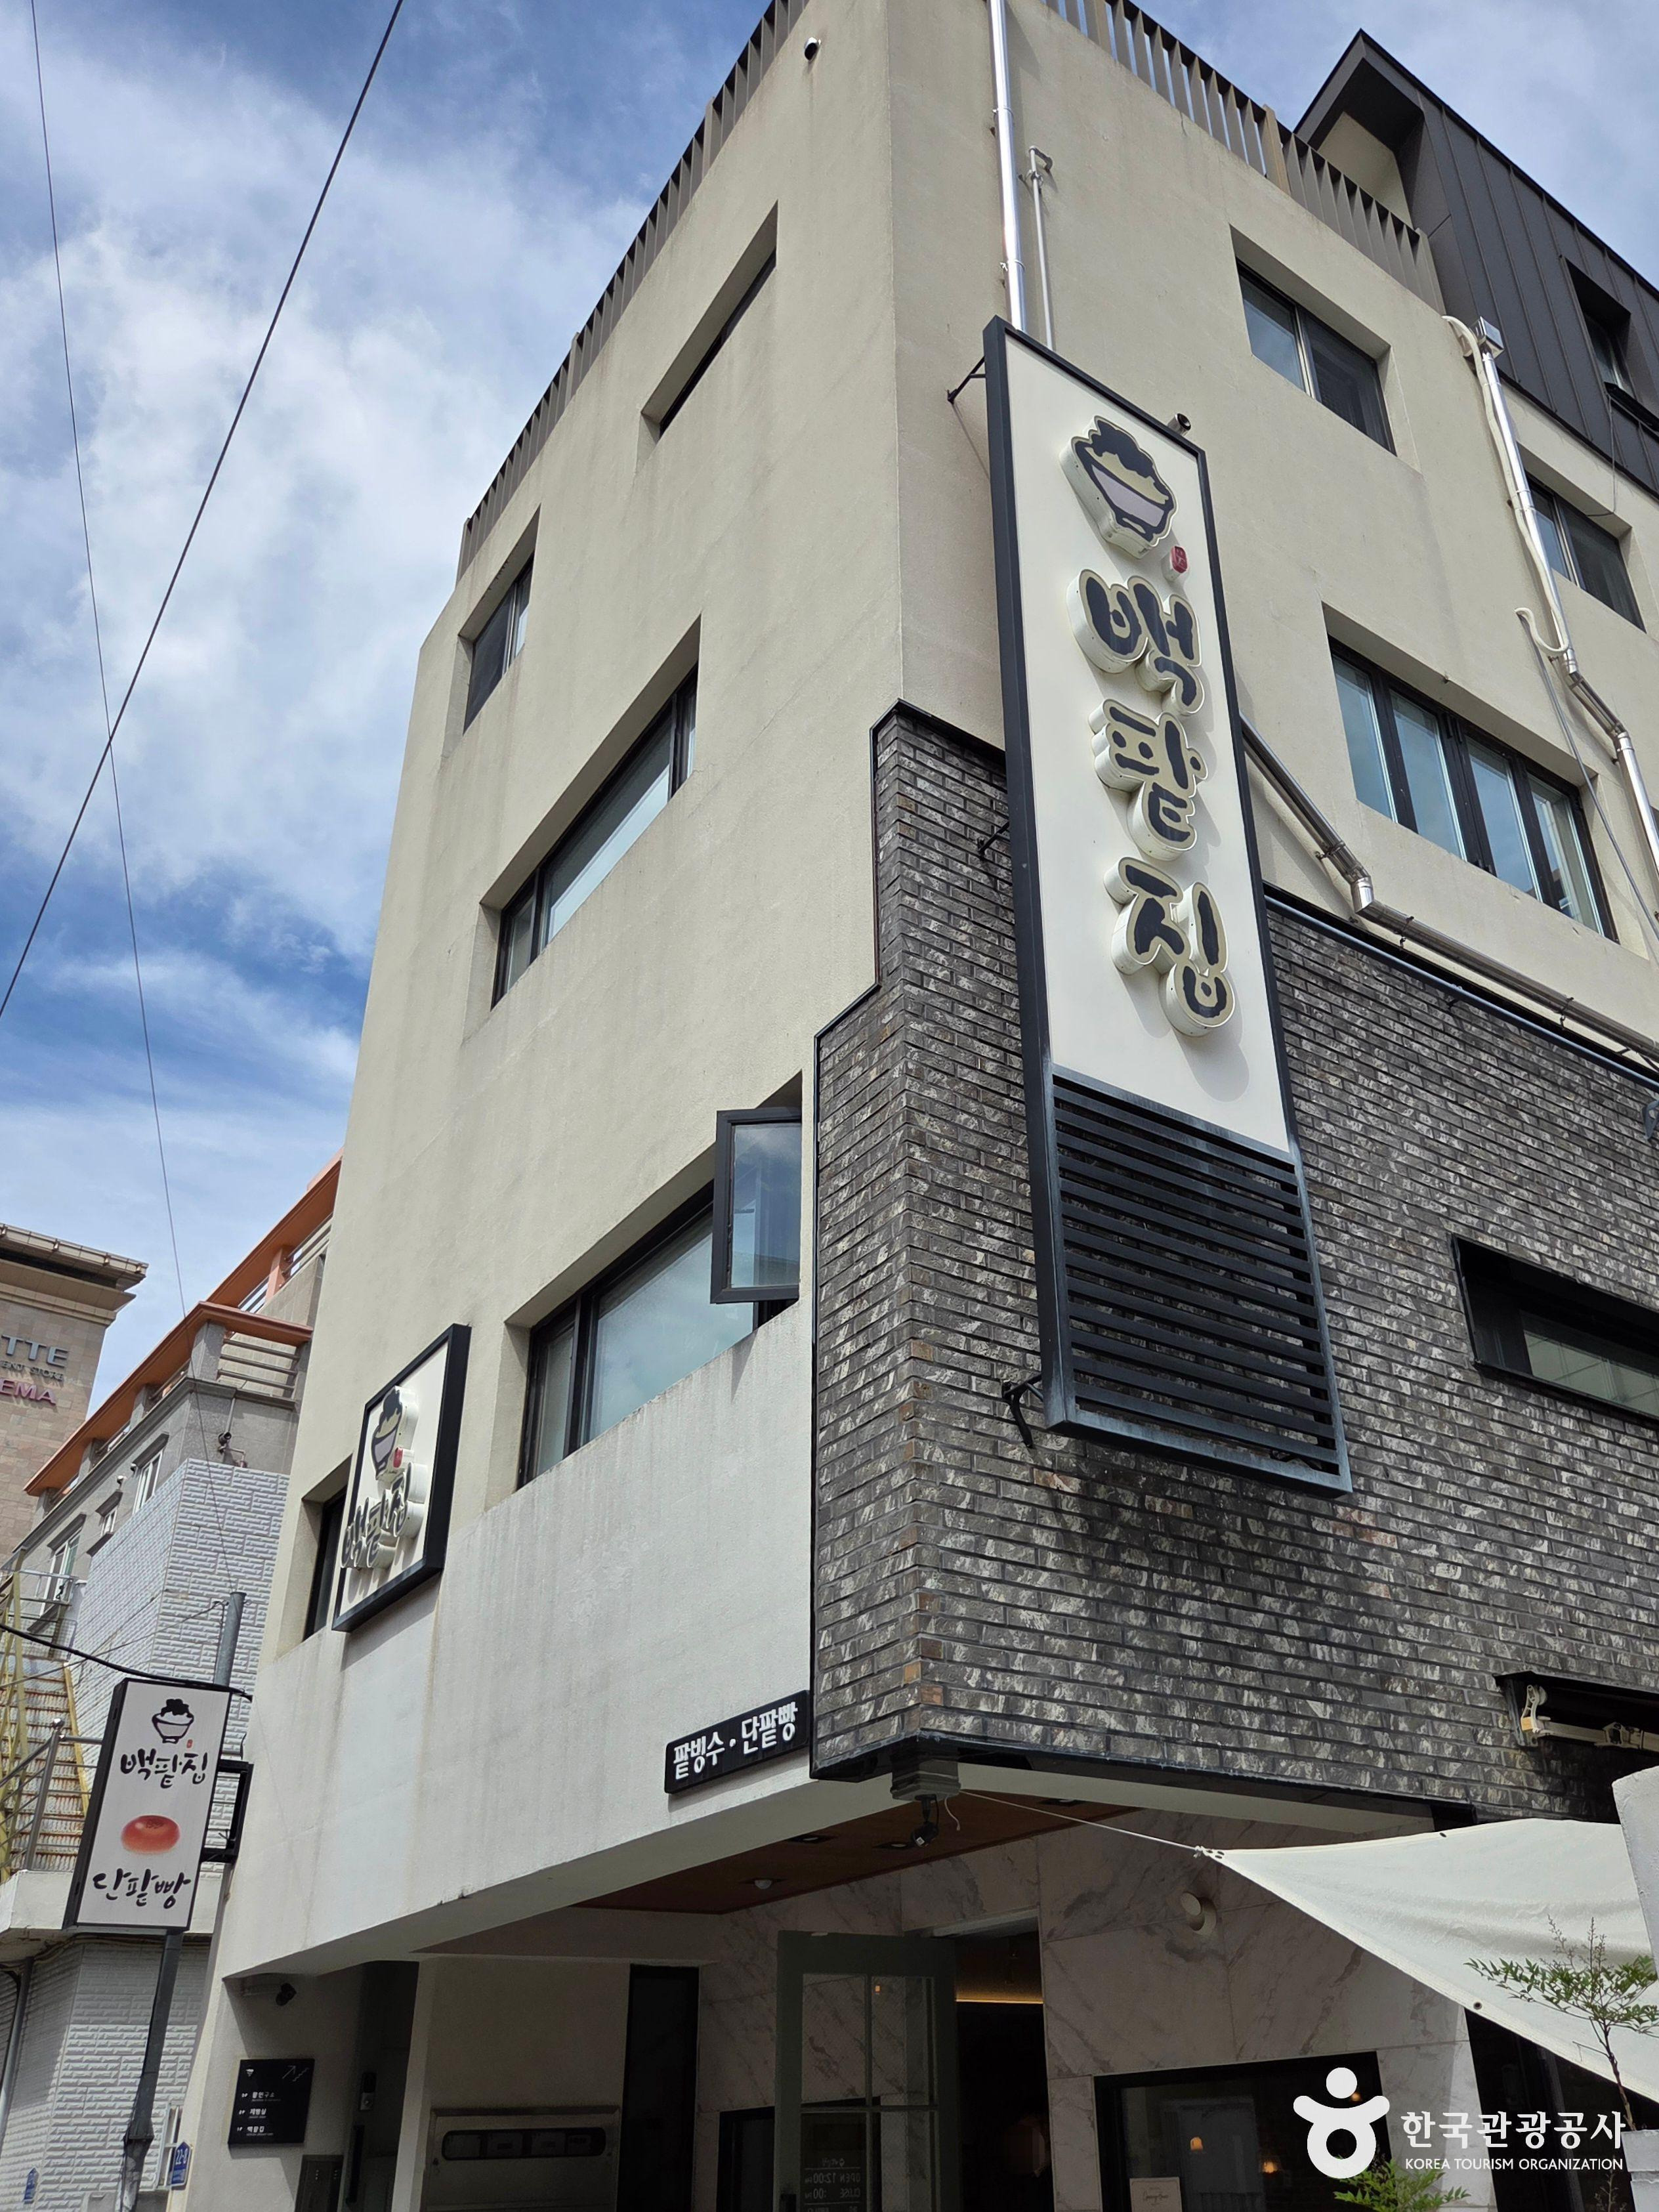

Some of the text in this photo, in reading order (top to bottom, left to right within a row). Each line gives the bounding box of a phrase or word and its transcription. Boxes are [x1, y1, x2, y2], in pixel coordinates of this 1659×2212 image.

[1083, 573, 1231, 1022] 백팥집
[120, 1748, 208, 1789] 백팥집
[93, 1868, 191, 1909] 단팥빵
